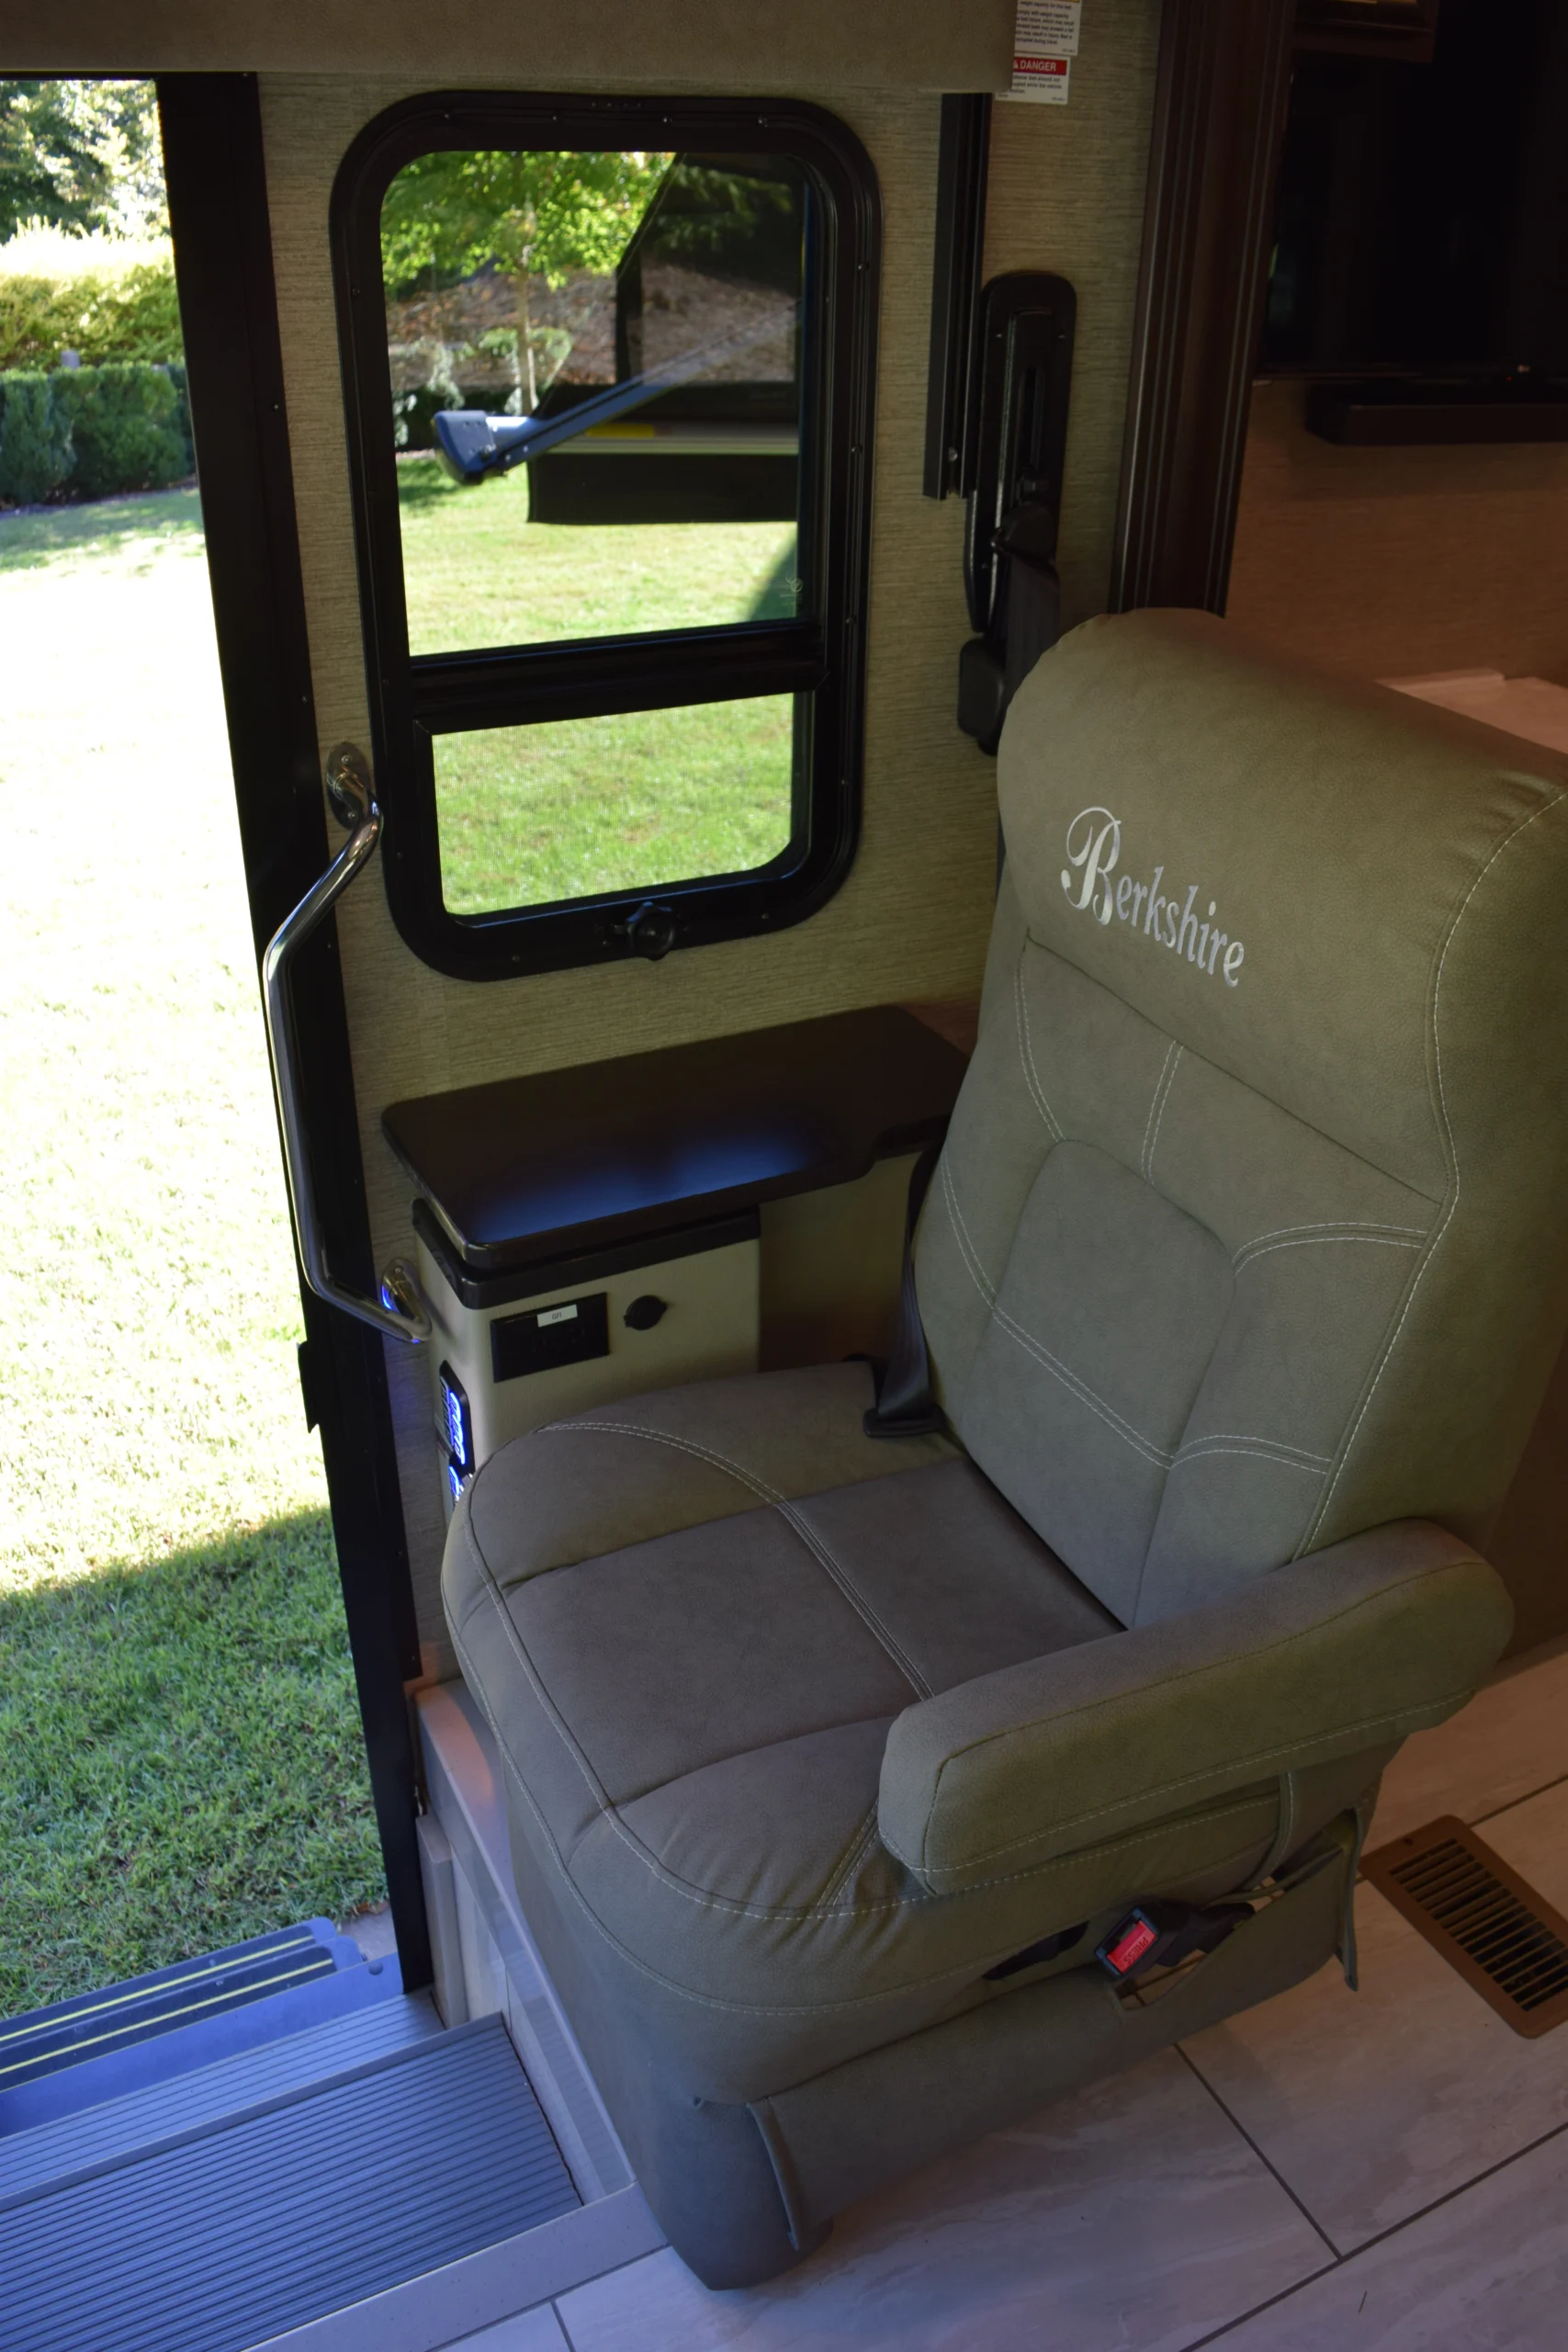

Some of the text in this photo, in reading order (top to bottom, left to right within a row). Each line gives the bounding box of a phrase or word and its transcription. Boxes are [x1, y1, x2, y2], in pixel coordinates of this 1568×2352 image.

[1020, 60, 1056, 71] DANGER
[1061, 807, 1245, 988] Berkshire
[1124, 1937, 1149, 1964] PRESS
